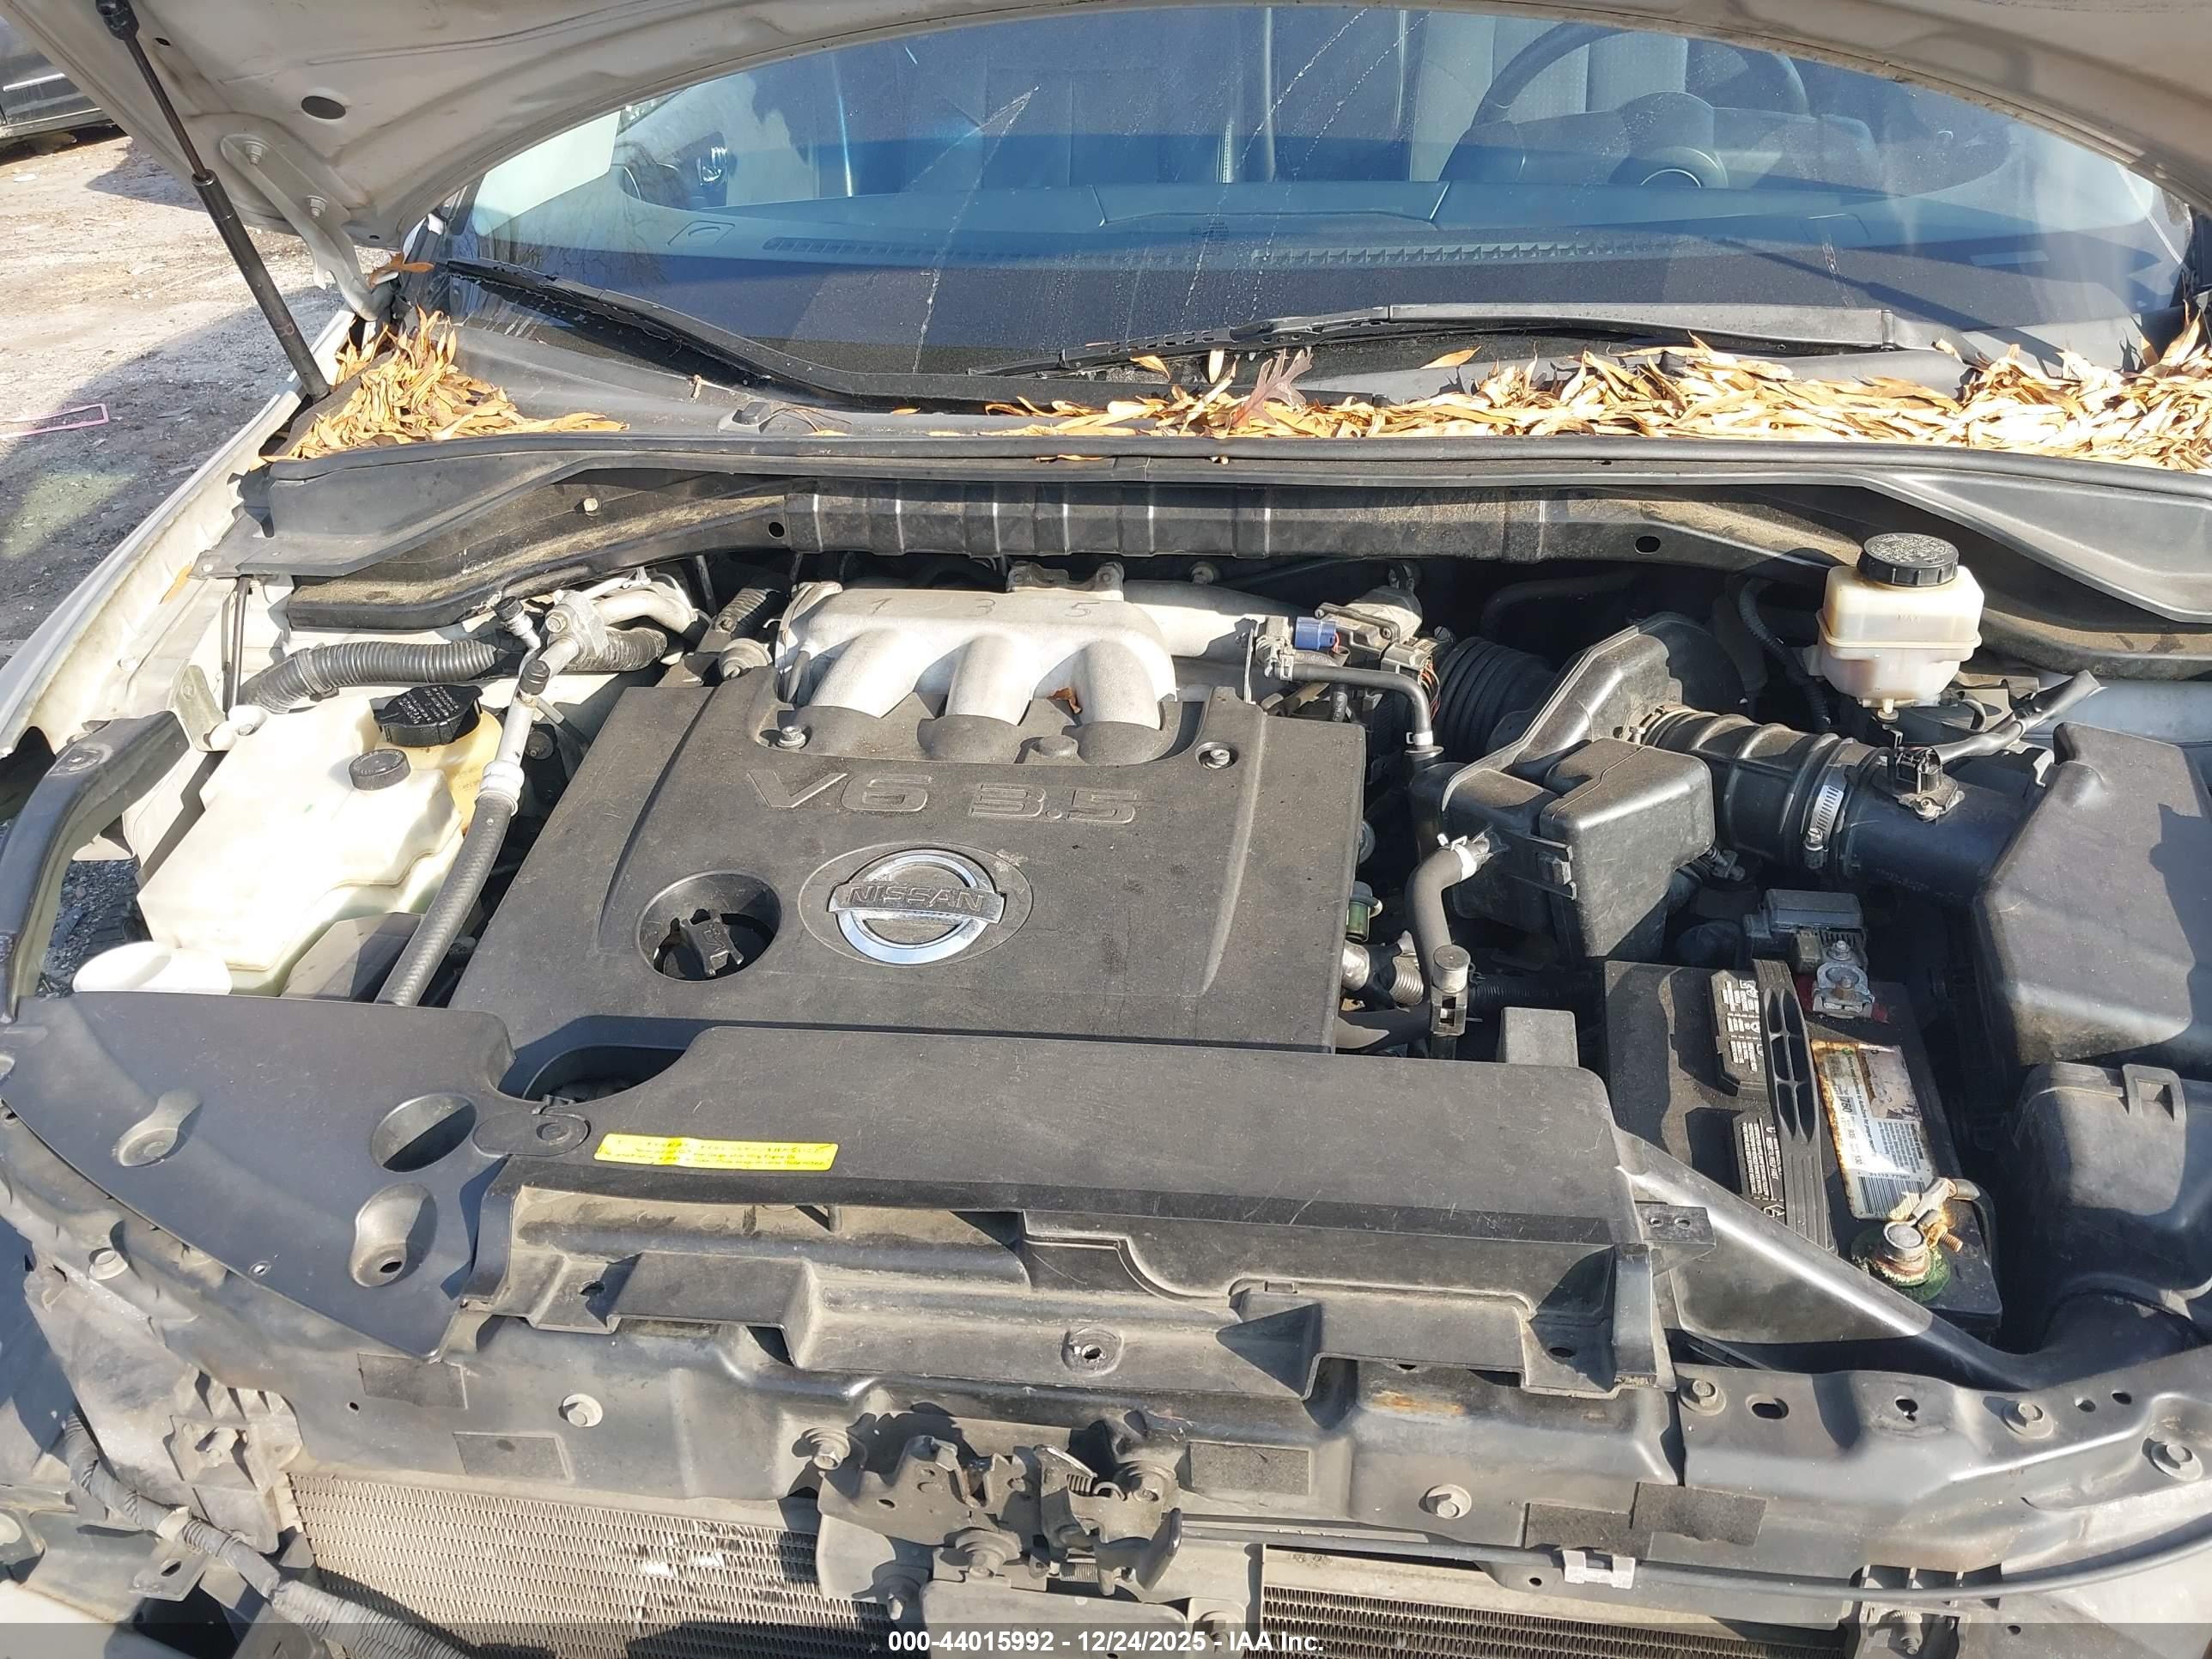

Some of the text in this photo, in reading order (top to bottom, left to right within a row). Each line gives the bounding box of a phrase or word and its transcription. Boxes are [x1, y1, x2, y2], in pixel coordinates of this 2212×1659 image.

[872, 598, 1101, 617] 1 3 5
[747, 769, 1140, 825] V6 3.5
[848, 885, 985, 913] NISSAN
[1841, 1097, 1853, 1113] 750
